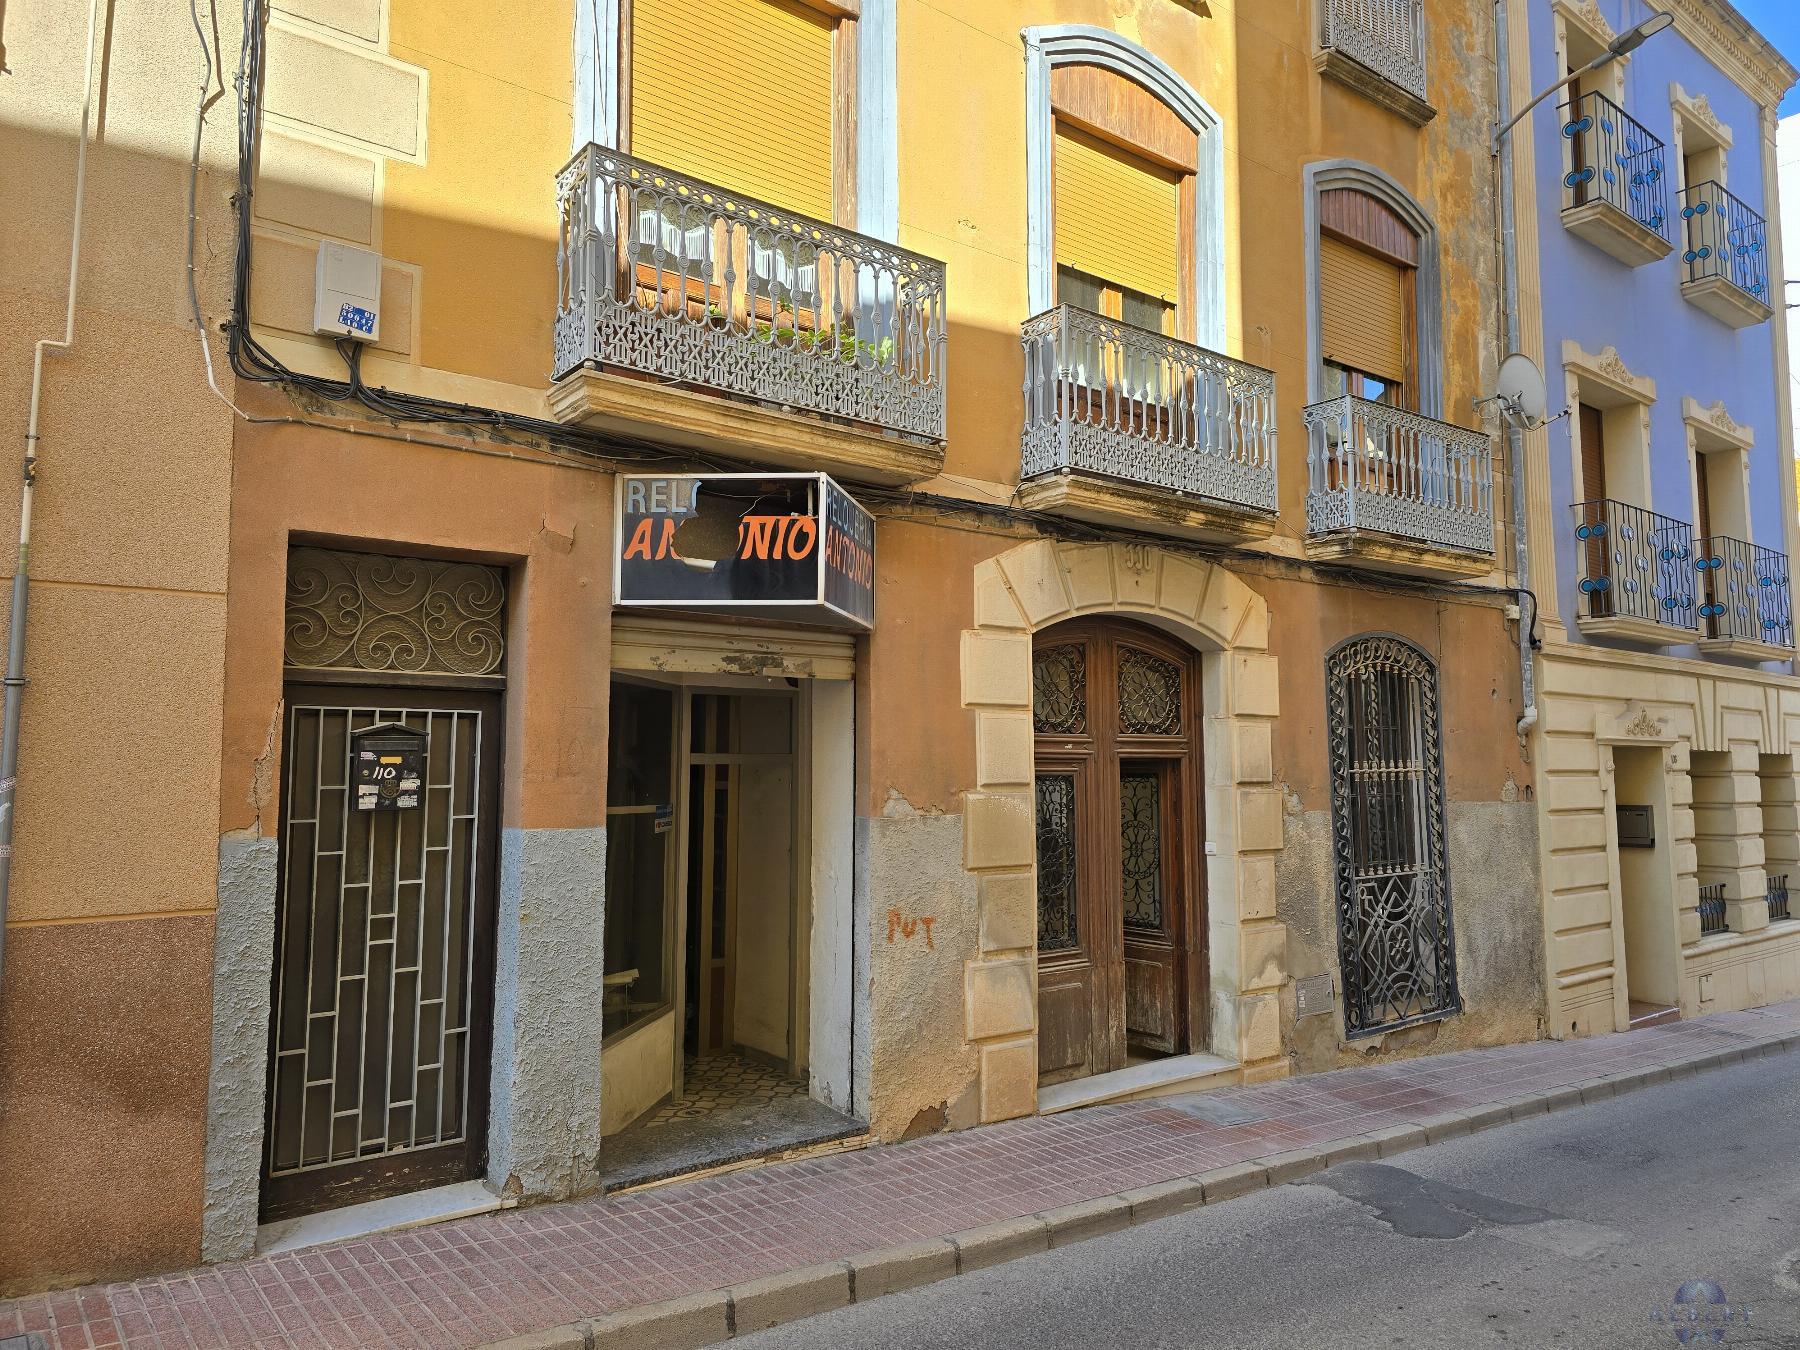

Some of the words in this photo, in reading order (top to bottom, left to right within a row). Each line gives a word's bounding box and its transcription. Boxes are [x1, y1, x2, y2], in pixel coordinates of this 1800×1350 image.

[824, 524, 873, 591] ANTONIO
[372, 766, 396, 780] 110
[886, 906, 937, 952] PUT
